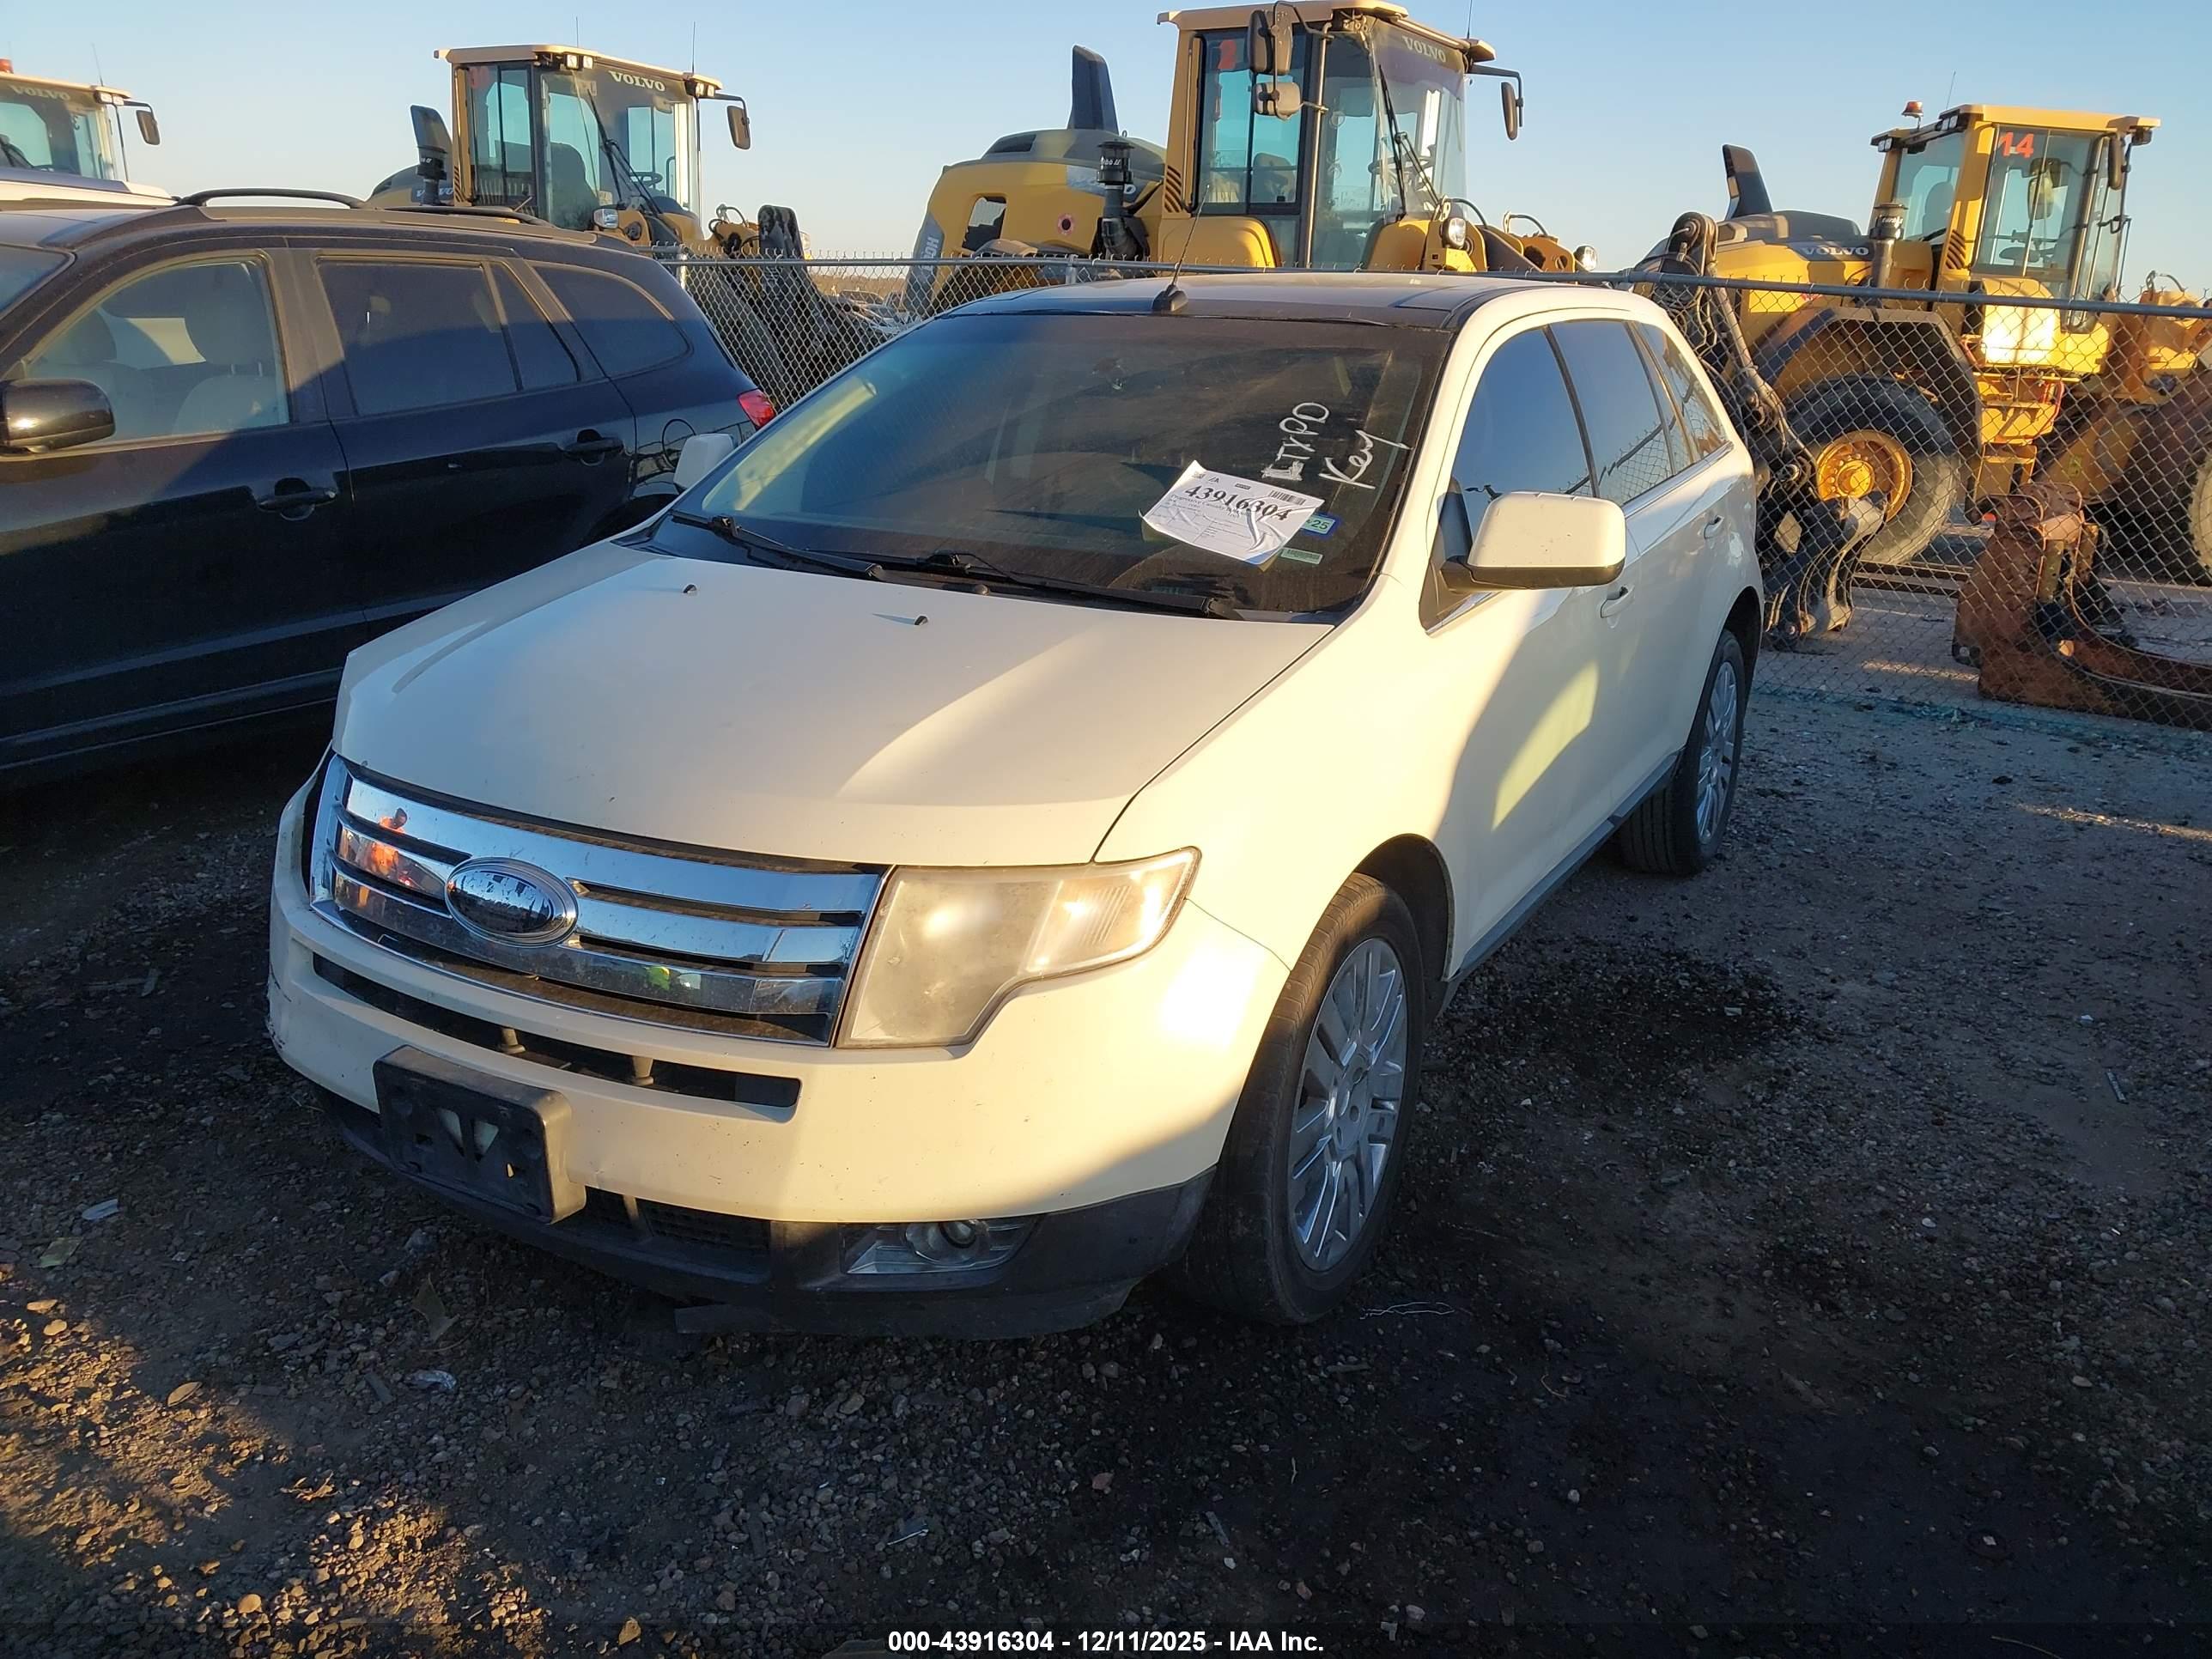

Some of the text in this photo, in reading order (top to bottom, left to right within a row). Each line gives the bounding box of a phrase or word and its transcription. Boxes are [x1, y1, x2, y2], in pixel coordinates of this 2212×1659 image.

[1218, 40, 1237, 70] 2
[1402, 35, 1446, 63] VOLVO
[9, 85, 70, 100] VOLVO
[608, 70, 665, 92] VOLVO
[1998, 131, 2034, 158] 14
[416, 187, 453, 198] VVO
[1802, 246, 1869, 255] VOLVO
[1318, 429, 1413, 489] Key
[1184, 485, 1292, 521] 43916304
[1311, 520, 1329, 530] 25
